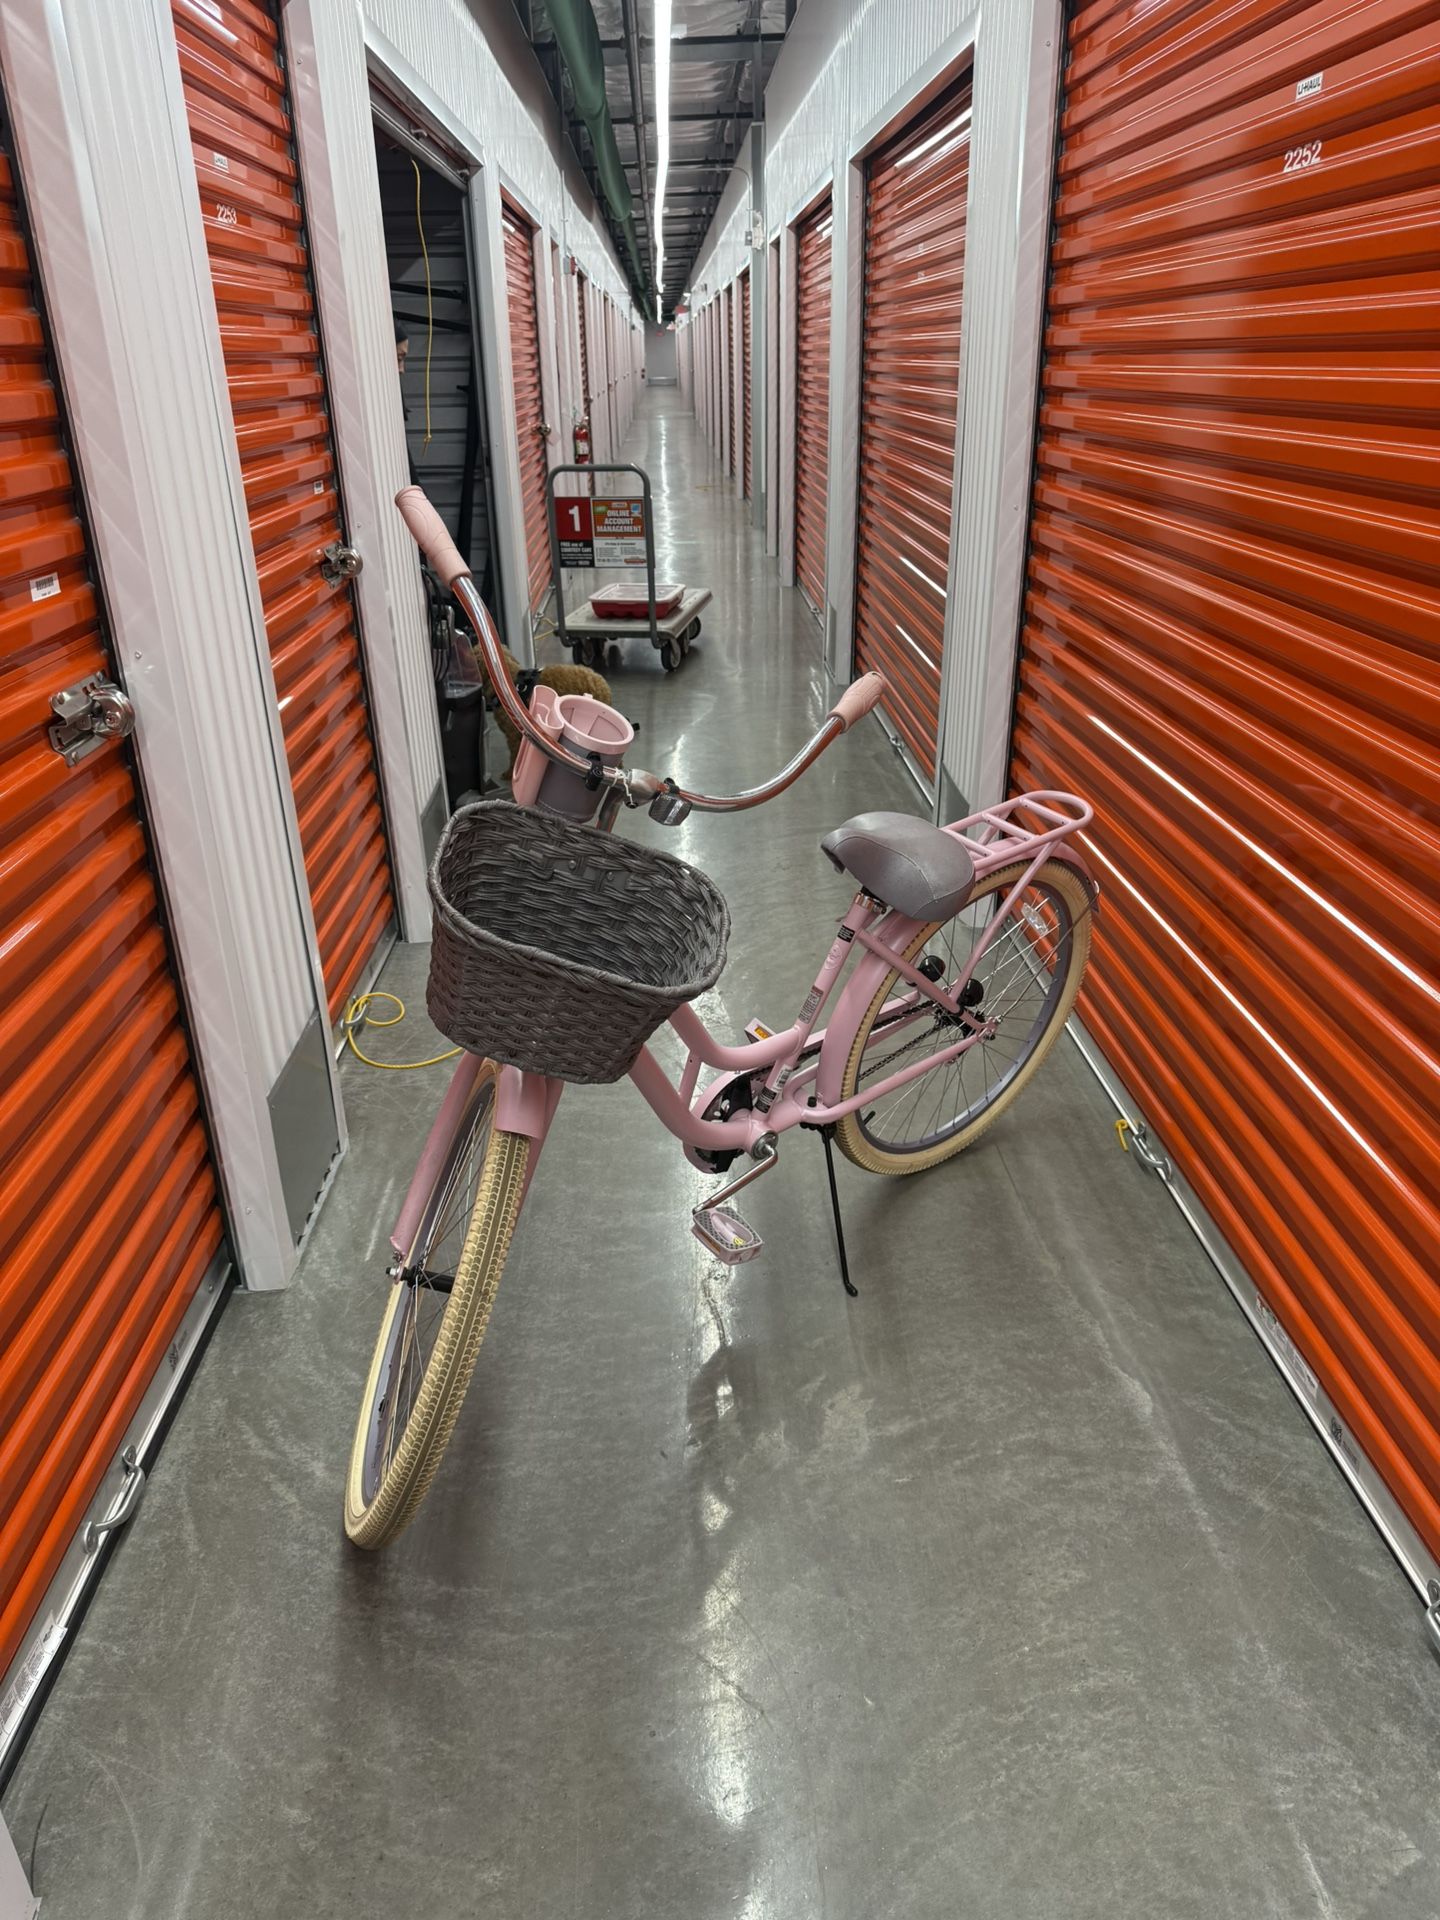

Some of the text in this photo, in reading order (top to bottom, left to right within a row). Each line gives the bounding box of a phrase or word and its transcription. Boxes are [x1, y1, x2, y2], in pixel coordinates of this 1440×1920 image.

[1297, 76, 1321, 95] U-HAUL
[1283, 140, 1322, 172] 2252
[216, 203, 237, 225] 2253
[569, 505, 581, 532] 1
[604, 517, 634, 525] ACCOUNT
[596, 525, 642, 533] MANAGEMENT
